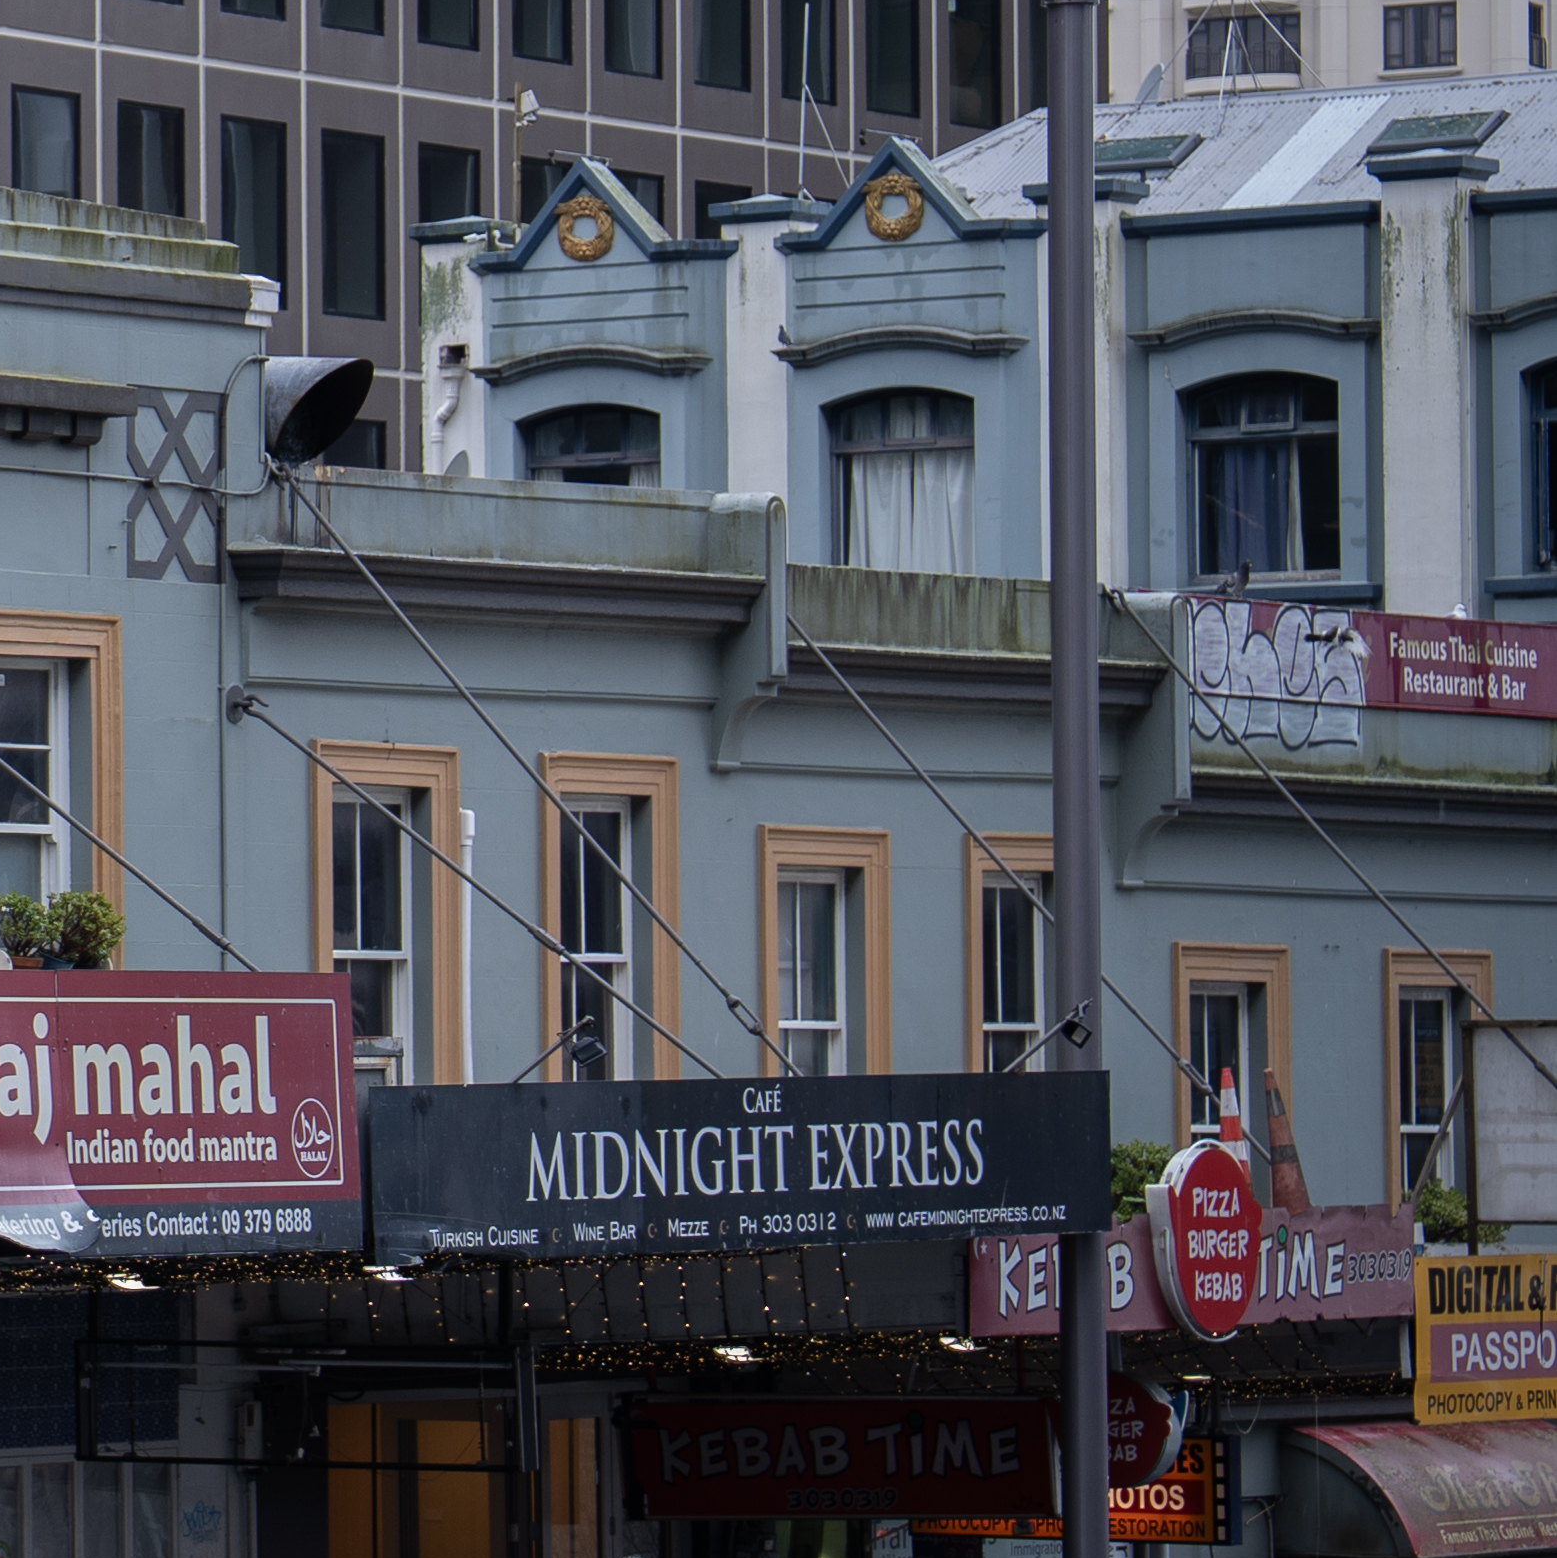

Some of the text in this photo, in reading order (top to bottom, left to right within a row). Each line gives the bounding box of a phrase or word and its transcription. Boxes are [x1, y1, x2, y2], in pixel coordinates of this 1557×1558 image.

[1389, 630, 1539, 671] Famous Thai Cuisine
[1402, 665, 1528, 702] Restaurant Bar
[72, 1014, 278, 1117] mahal
[741, 1083, 782, 1114] CAFÉ
[66, 1128, 278, 1165] Indian food mantra
[525, 1117, 985, 1203] MIDNIGHT EXPRESS
[1191, 1186, 1241, 1219] PIZZA
[145, 1211, 210, 1237] Contact
[221, 1209, 240, 1235] 09
[244, 1209, 272, 1234] 379
[275, 1208, 313, 1233] 6888
[428, 1228, 484, 1248] TURKISH
[487, 1225, 540, 1246] CUISINE
[572, 1222, 606, 1243] WINE
[609, 1221, 637, 1241] BAR
[667, 1217, 711, 1238] MEZZE
[761, 1212, 794, 1234] 303
[796, 1211, 838, 1233] 0312
[1186, 1228, 1250, 1262] BURGER
[1346, 1248, 1413, 1285] 3030319
[1193, 1269, 1244, 1304] KEBAB
[1428, 1264, 1525, 1316] DIGITAL
[1427, 1392, 1513, 1417] PHOTOCOPY
[657, 1422, 851, 1486] KEBAB
[785, 1486, 899, 1512] 3030319
